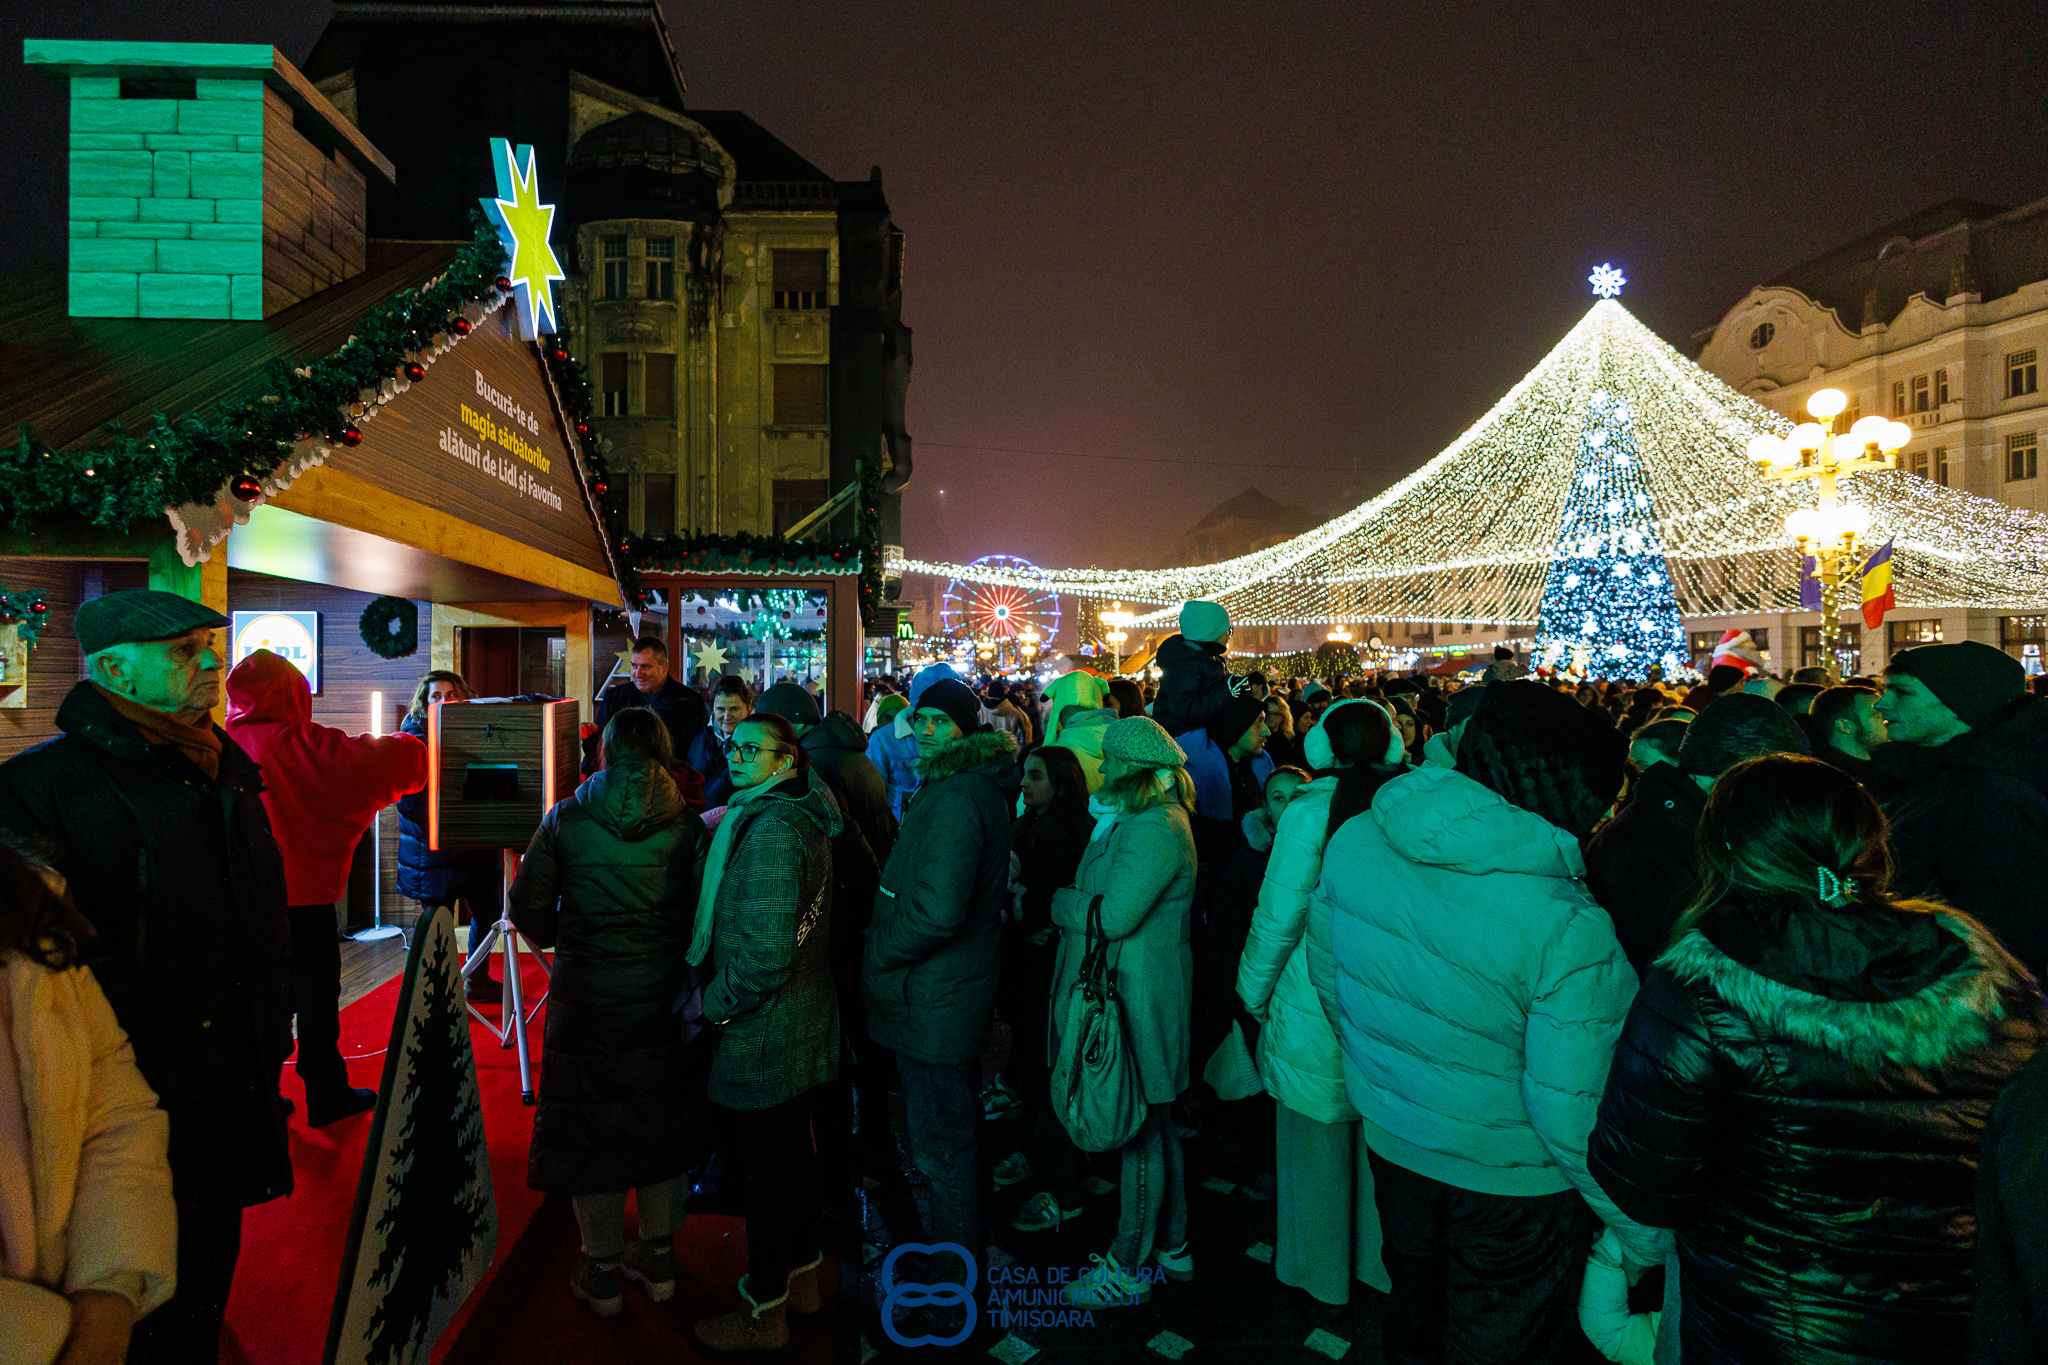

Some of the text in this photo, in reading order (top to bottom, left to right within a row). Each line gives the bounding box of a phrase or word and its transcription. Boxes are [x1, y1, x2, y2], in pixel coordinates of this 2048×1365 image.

[460, 402, 551, 475] magia sărbătorilor
[475, 369, 539, 436] Bucură-te de
[439, 426, 562, 511] alături de Lidl și Favorina
